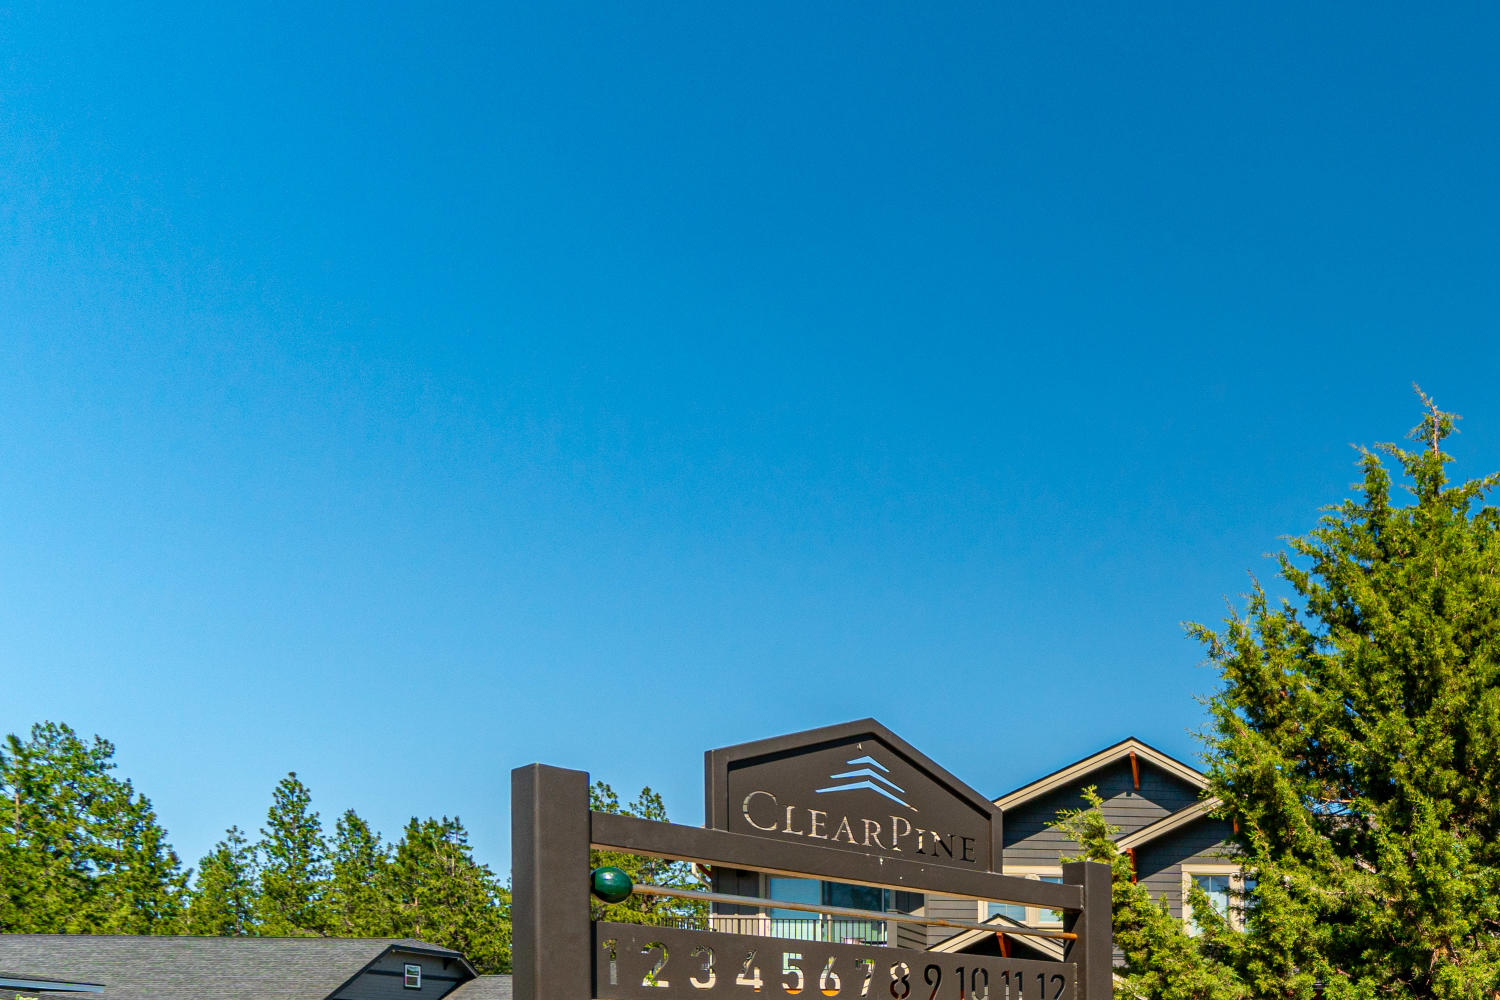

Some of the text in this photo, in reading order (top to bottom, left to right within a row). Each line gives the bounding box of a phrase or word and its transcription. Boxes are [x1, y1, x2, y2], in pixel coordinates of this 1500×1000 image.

[602, 938, 617, 985] 1
[641, 942, 670, 988] 2
[690, 945, 716, 990] 3
[736, 950, 763, 992] 4
[781, 952, 804, 995] 5
[819, 956, 841, 996] 6
[855, 959, 875, 997] 7
[889, 961, 911, 1000] 8
[924, 964, 942, 1000] 9
